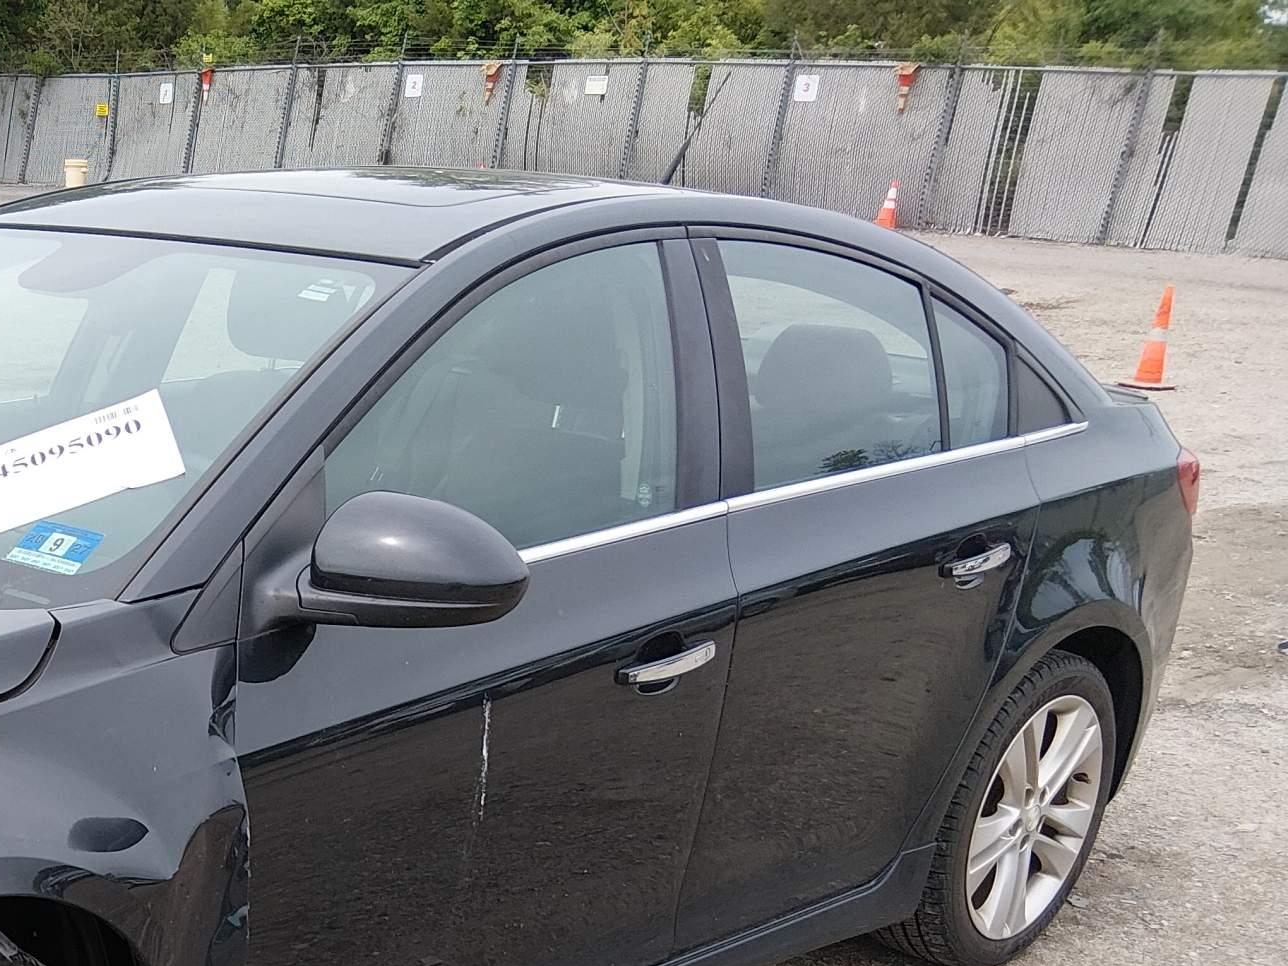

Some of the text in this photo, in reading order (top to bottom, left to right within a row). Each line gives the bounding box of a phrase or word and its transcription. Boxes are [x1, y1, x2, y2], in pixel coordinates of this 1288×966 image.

[411, 80, 417, 90] 2
[803, 82, 810, 92] 3
[49, 537, 65, 552] 9
